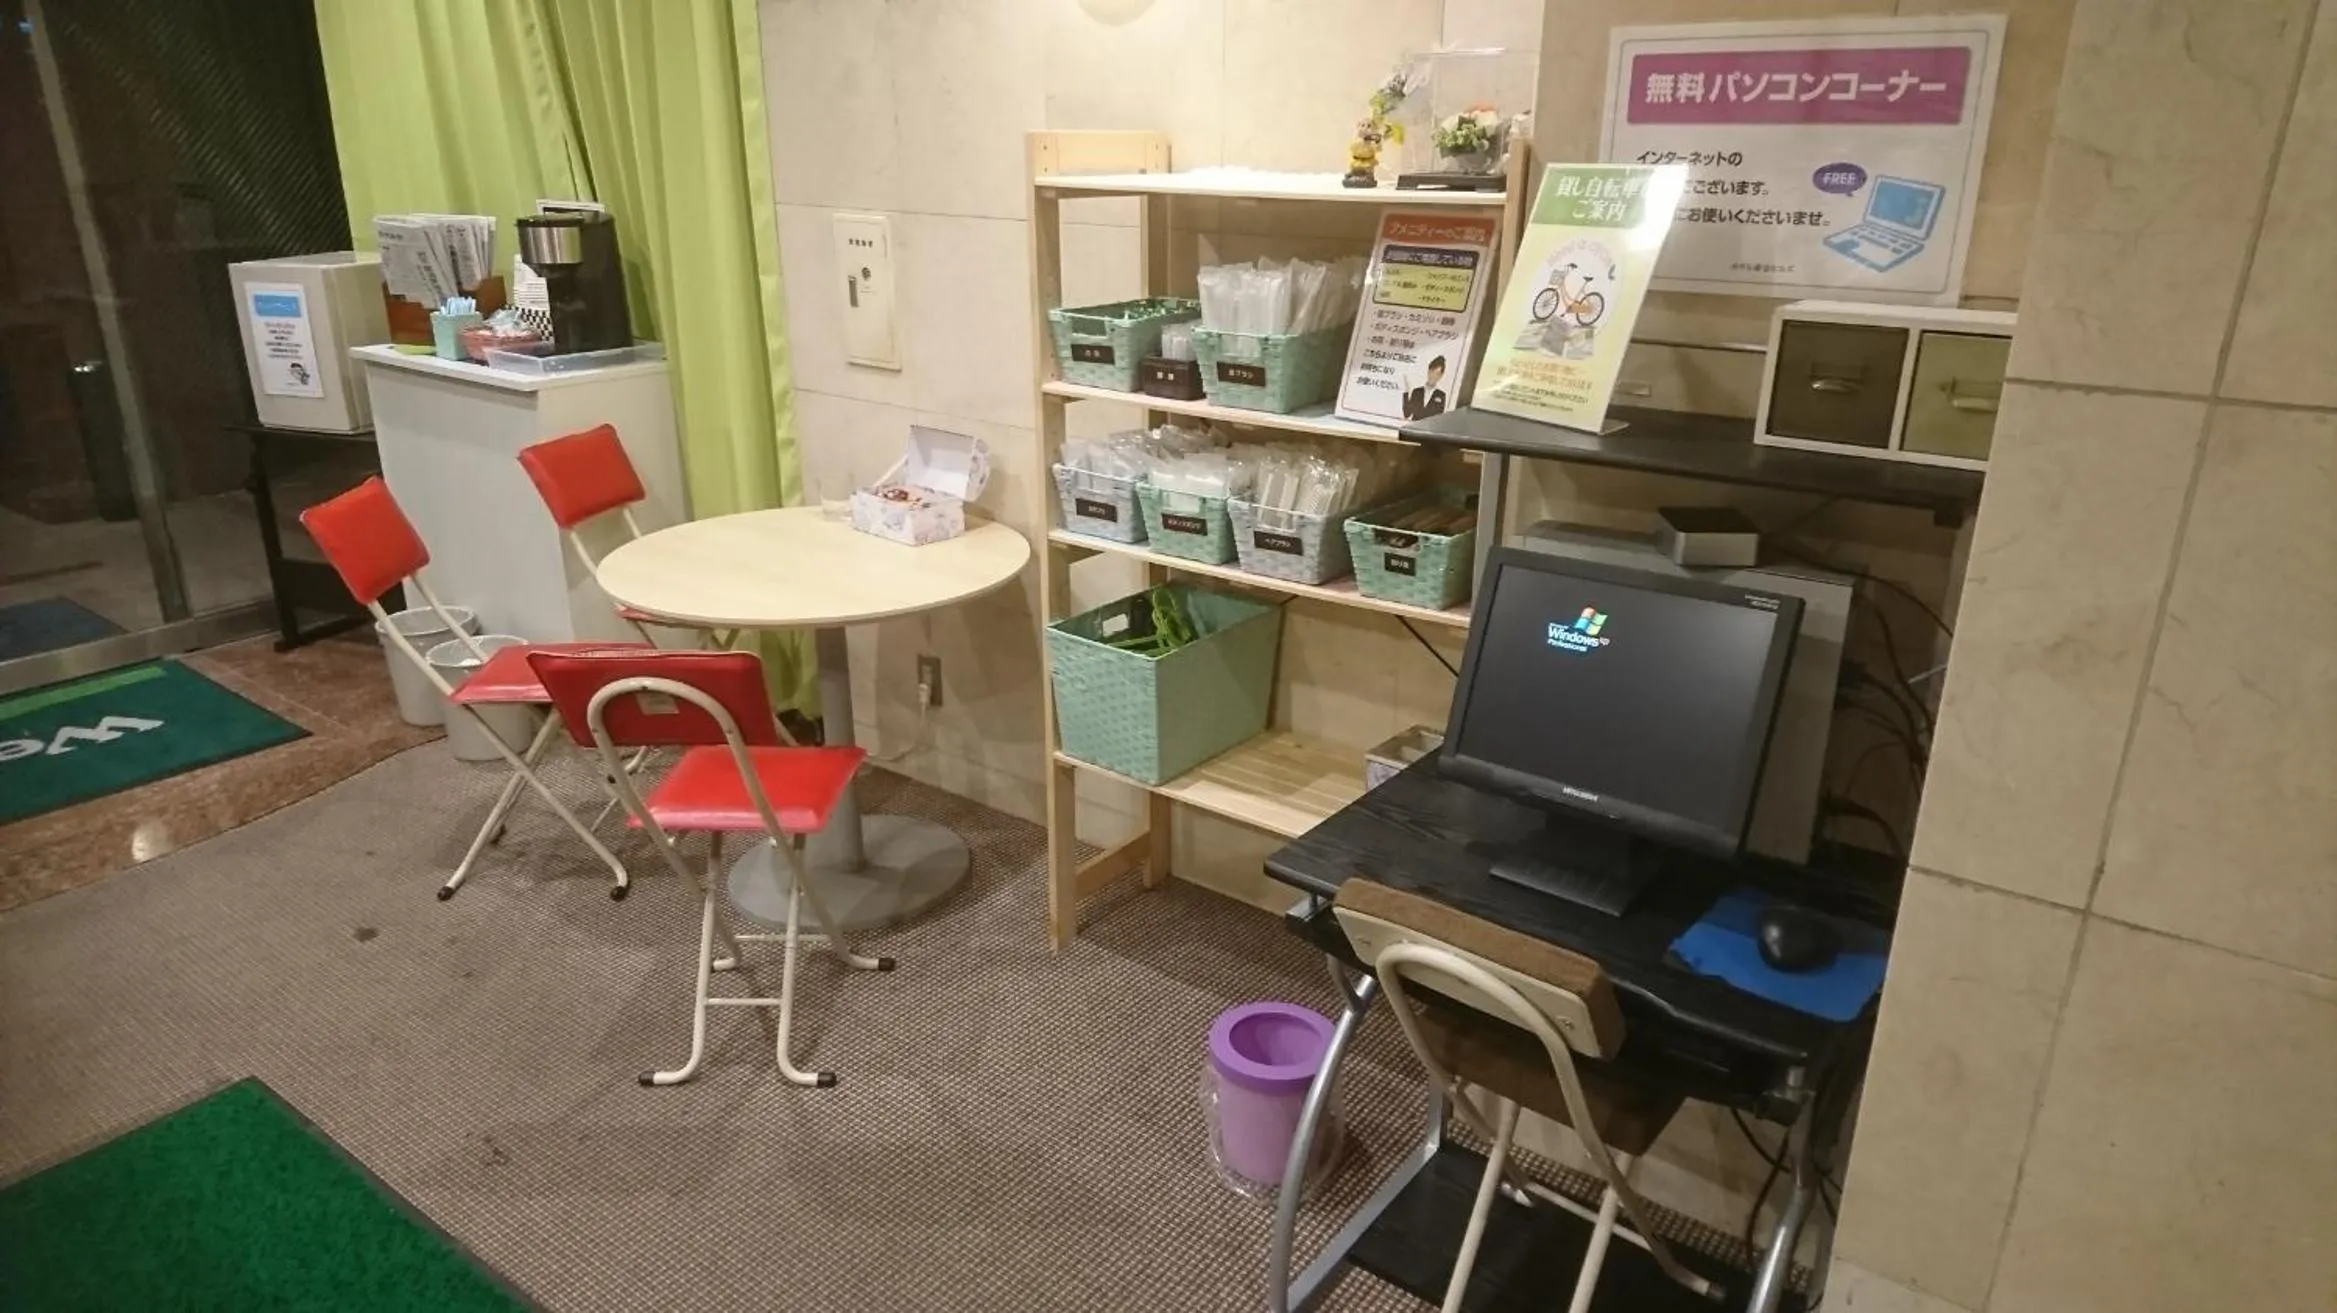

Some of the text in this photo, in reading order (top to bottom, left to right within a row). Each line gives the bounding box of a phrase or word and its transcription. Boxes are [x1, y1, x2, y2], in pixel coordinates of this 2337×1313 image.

[1645, 70, 1947, 104] 無料パソコンコーナー
[1636, 151, 1743, 167] インターネットの
[1823, 172, 1856, 187] FREE
[1572, 199, 1627, 221] ご案内
[1549, 626, 1599, 647] Windows
